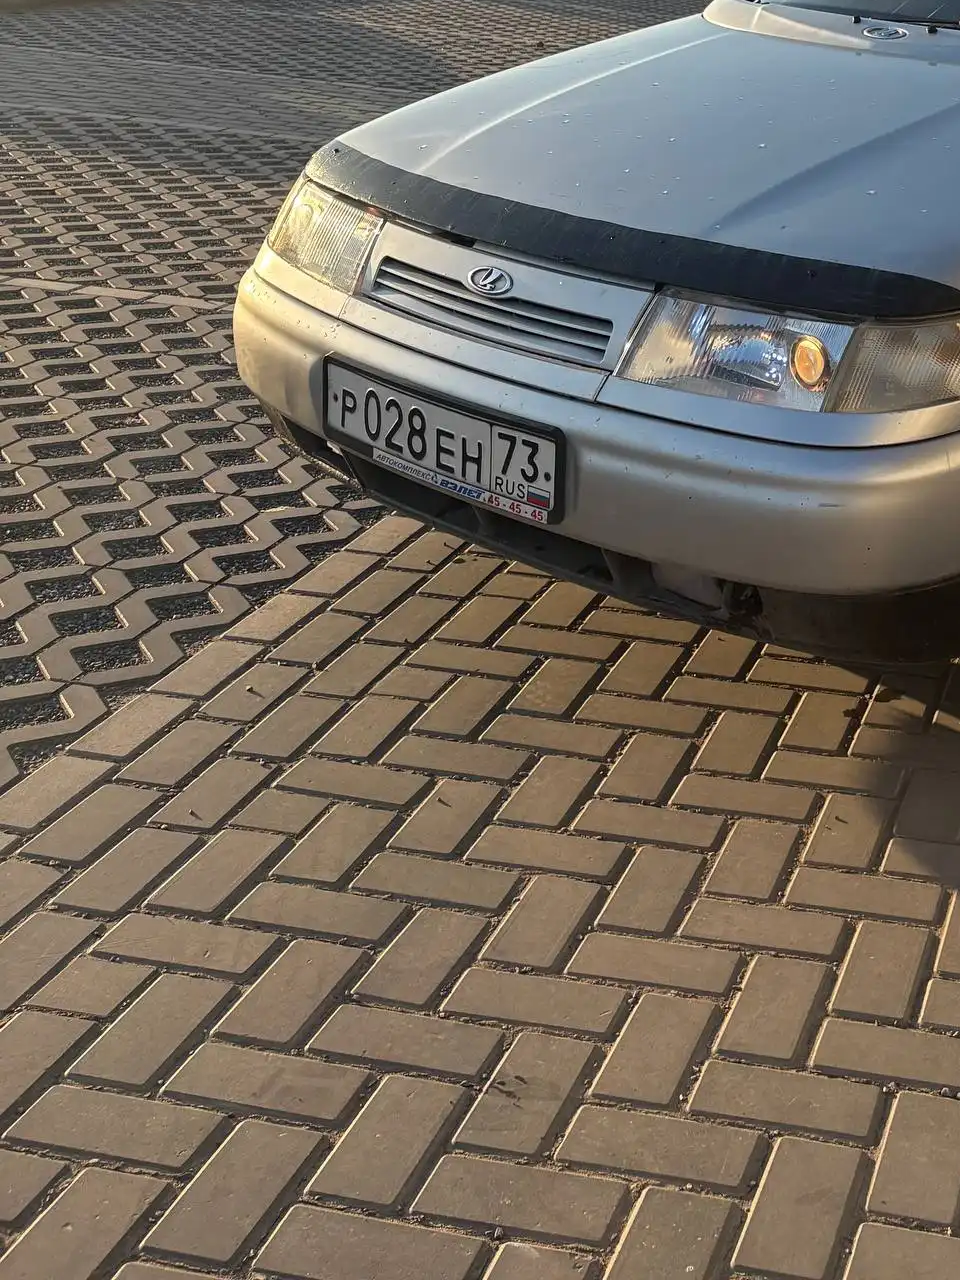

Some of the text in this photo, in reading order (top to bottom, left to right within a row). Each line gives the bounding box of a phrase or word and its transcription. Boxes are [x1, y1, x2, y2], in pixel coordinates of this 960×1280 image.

[376, 453, 432, 481] АВТОКОМПЛЕКС
[498, 431, 540, 483] 73
[495, 476, 525, 499] RUS
